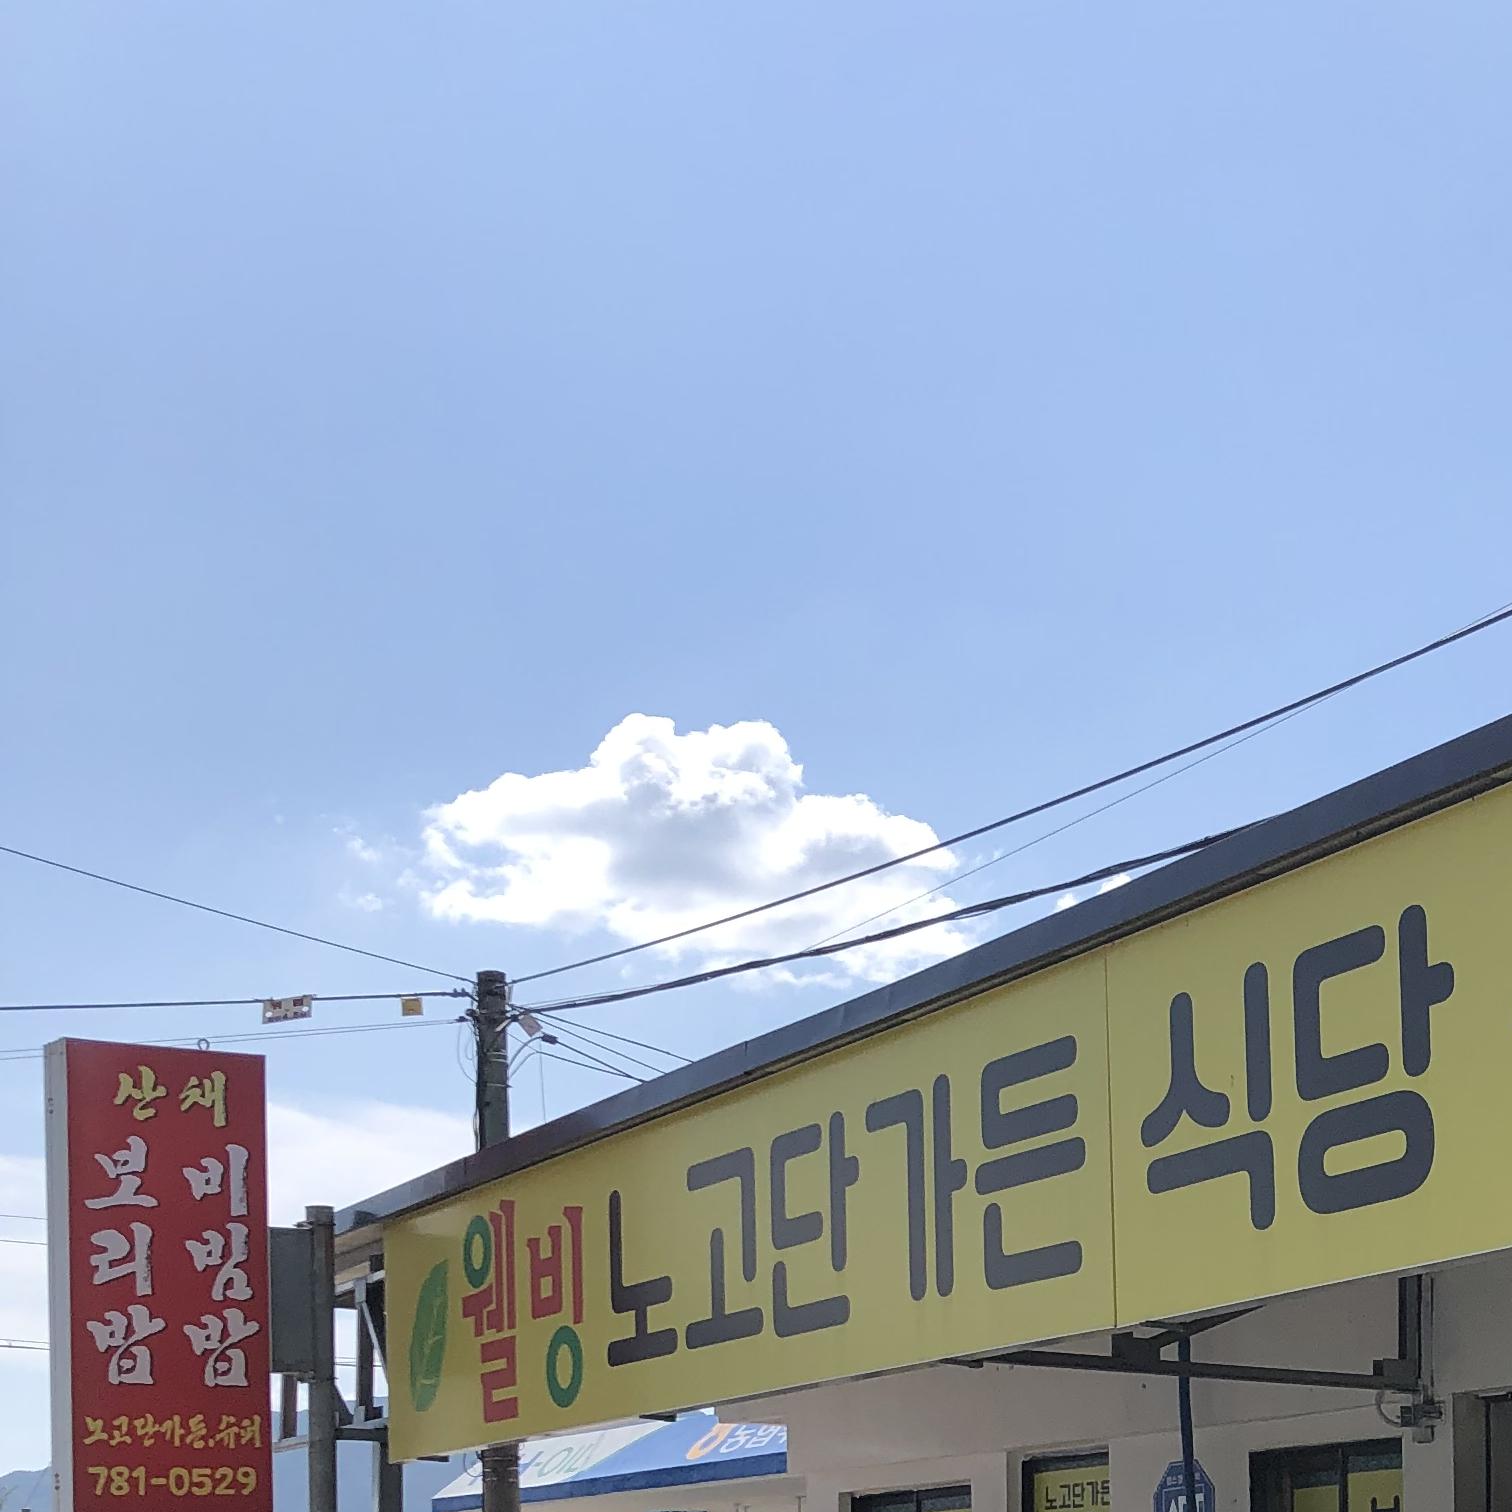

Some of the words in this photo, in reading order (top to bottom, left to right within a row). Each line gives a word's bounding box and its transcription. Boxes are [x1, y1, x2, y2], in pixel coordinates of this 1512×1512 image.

[114, 1065, 229, 1128] 산채
[462, 1199, 583, 1423] 웰빙
[607, 1035, 1086, 1368] 노고단가든
[1140, 904, 1455, 1231] 식당
[85, 1135, 167, 1386] 보리밥
[182, 1143, 260, 1388] 비빔밥
[87, 1466, 258, 1497] 781-0529
